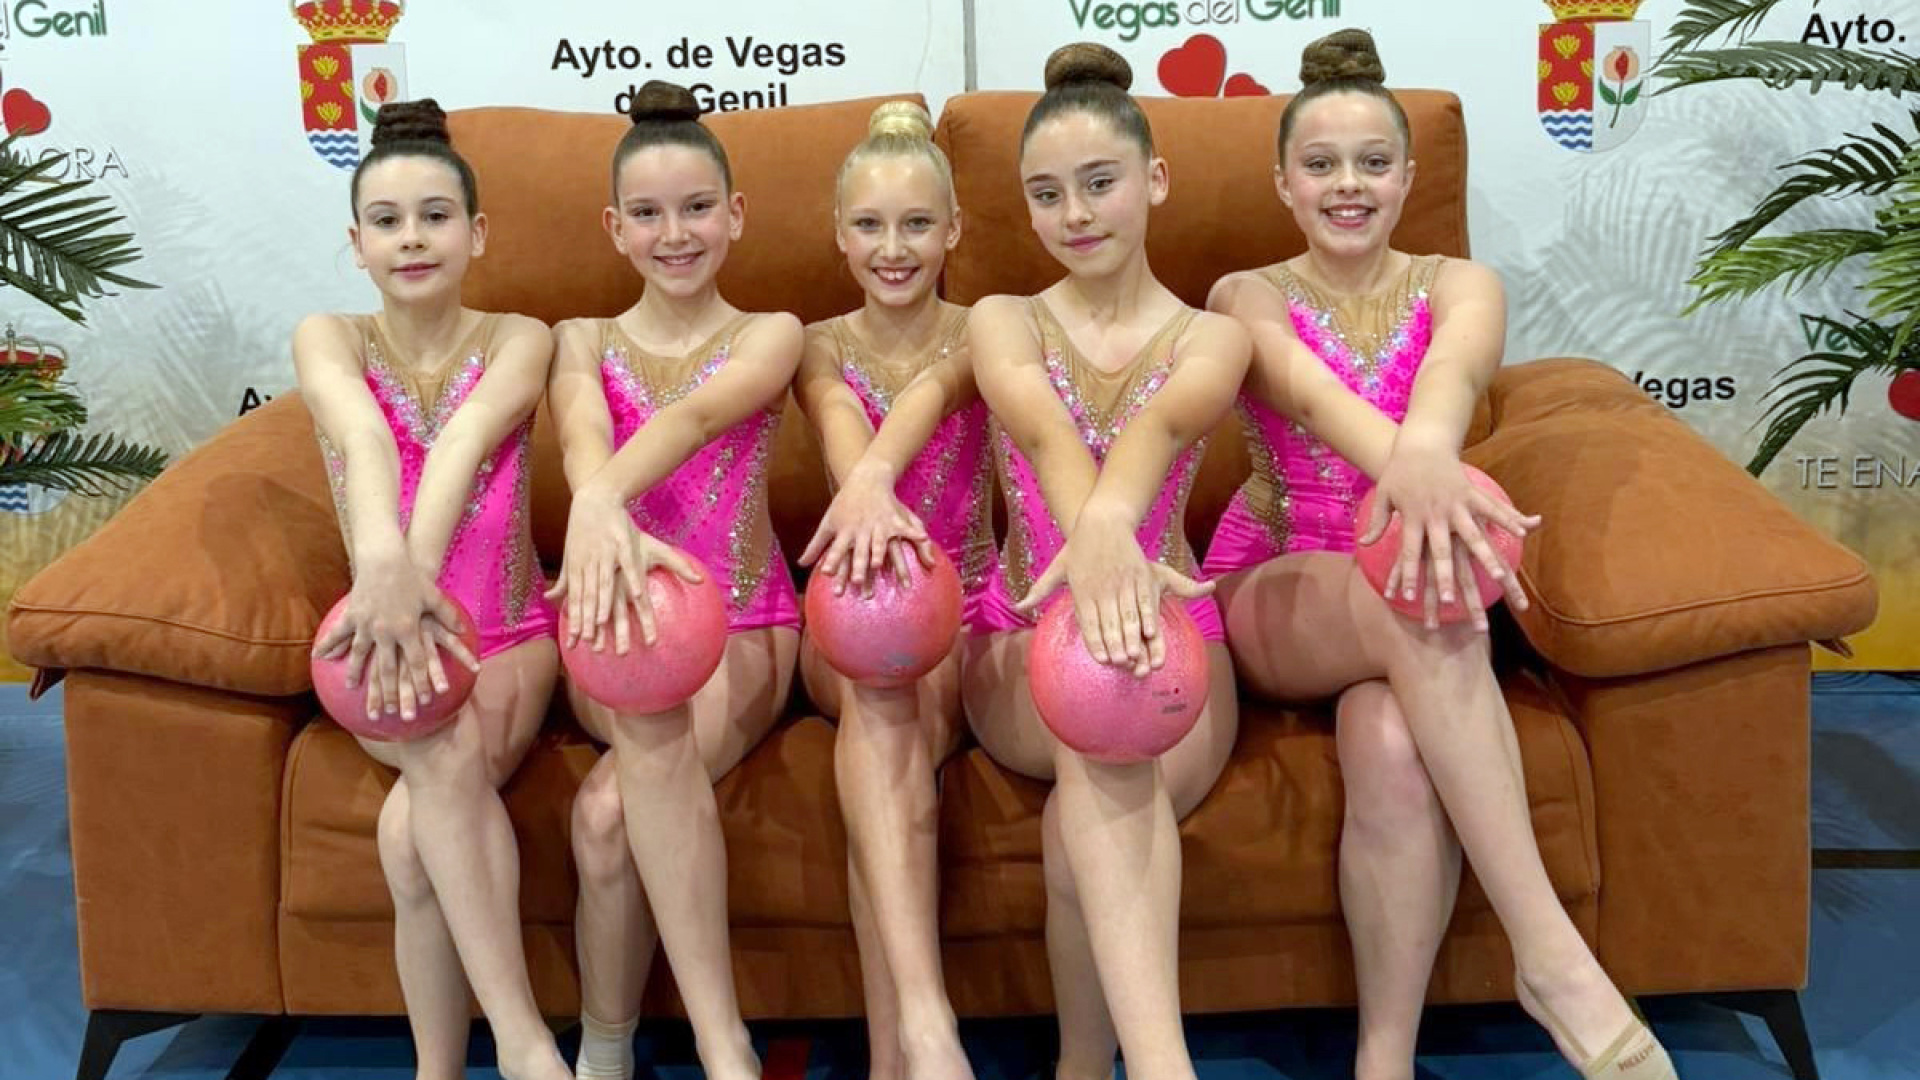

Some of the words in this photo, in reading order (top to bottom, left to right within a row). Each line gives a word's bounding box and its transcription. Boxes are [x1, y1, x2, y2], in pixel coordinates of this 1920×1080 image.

[14, 0, 108, 38] Genil
[1070, 0, 1180, 42] Vegas
[1184, 0, 1240, 24] del
[1801, 13, 1906, 48] Ayto.
[551, 38, 653, 78] Ayto.
[666, 37, 714, 69] de
[725, 36, 846, 76] Vegas
[688, 83, 788, 114] Genil
[1796, 455, 1839, 489] TE
